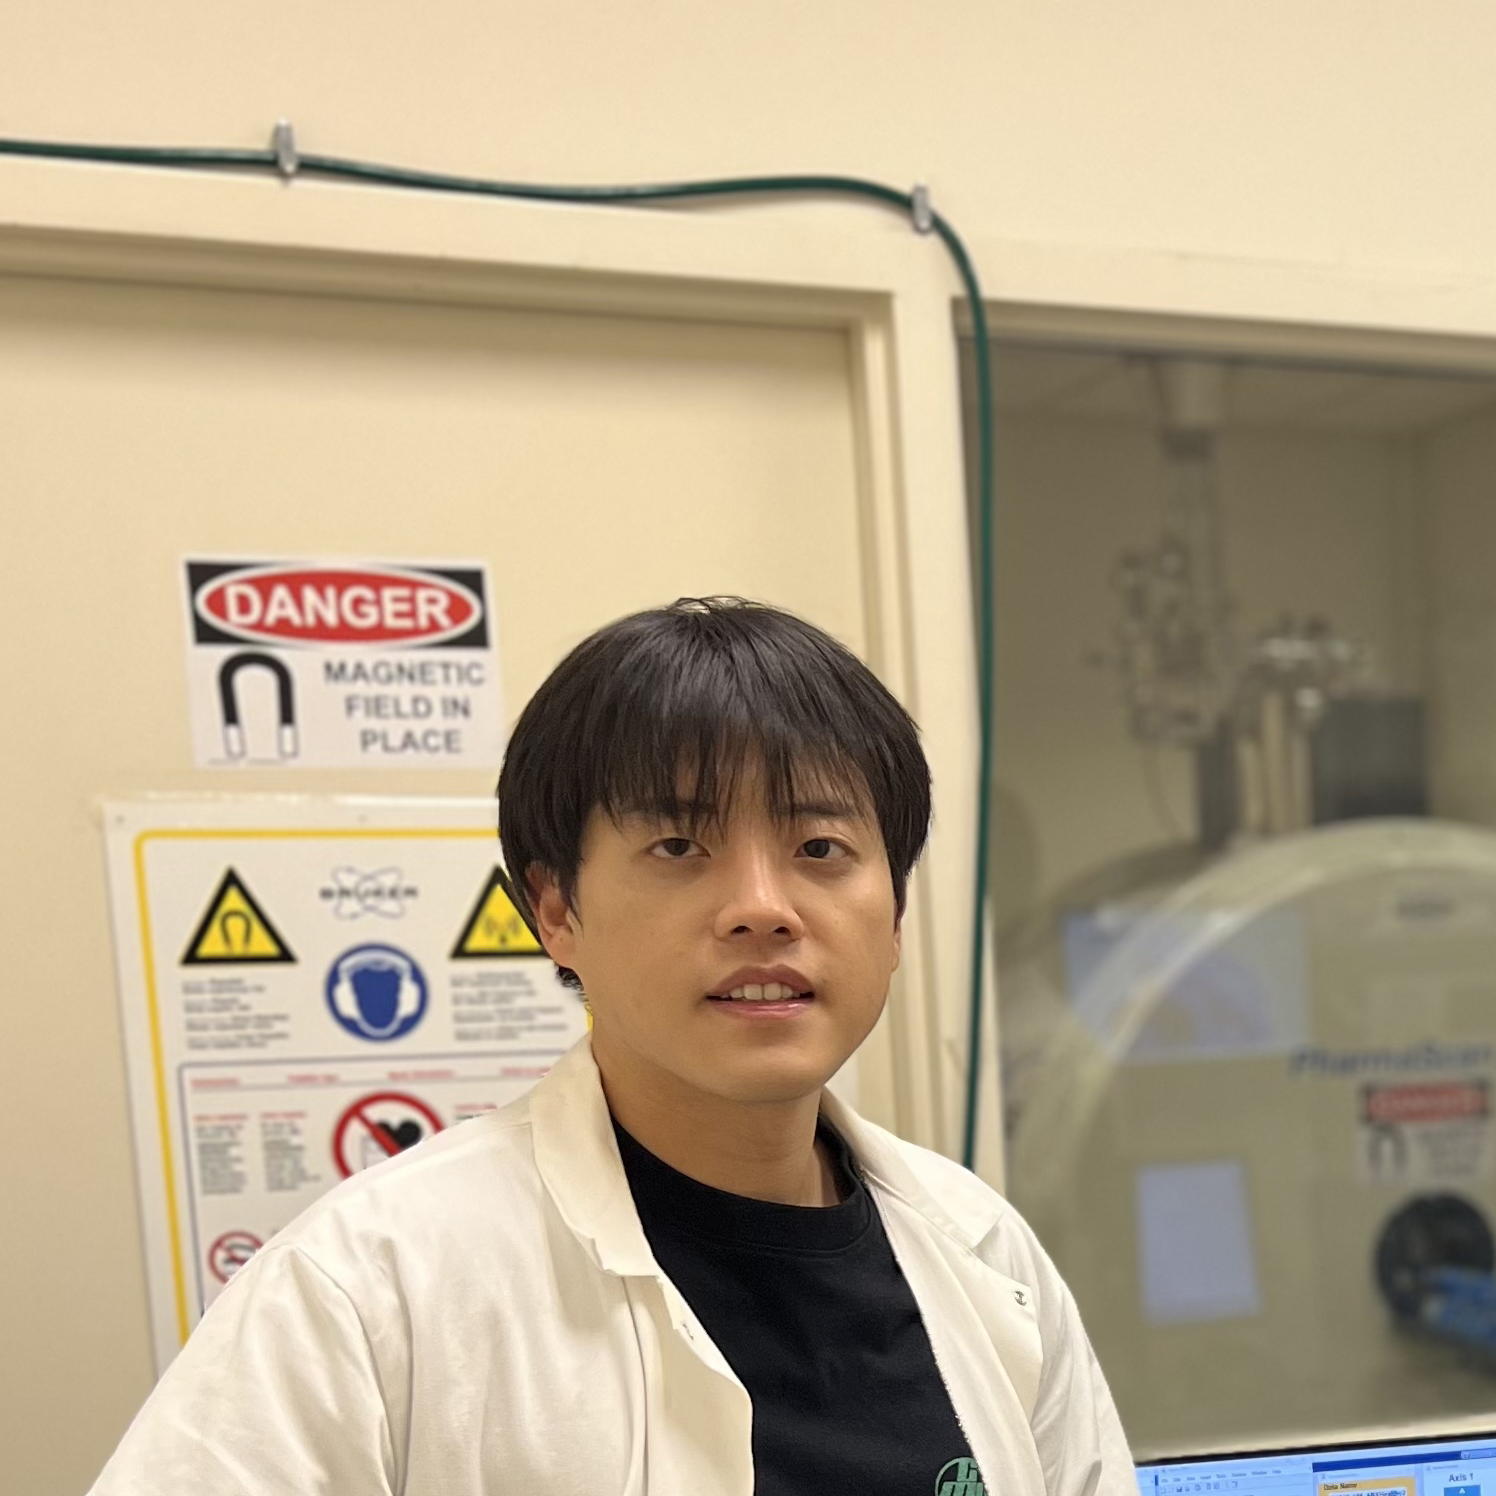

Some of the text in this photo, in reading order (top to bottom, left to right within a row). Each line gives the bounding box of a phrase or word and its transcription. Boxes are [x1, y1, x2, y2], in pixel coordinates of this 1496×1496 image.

[223, 582, 453, 631] DANGER
[323, 660, 486, 687] MAGNETIC
[345, 695, 471, 719] FIELD IN
[360, 729, 462, 754] PLACE
